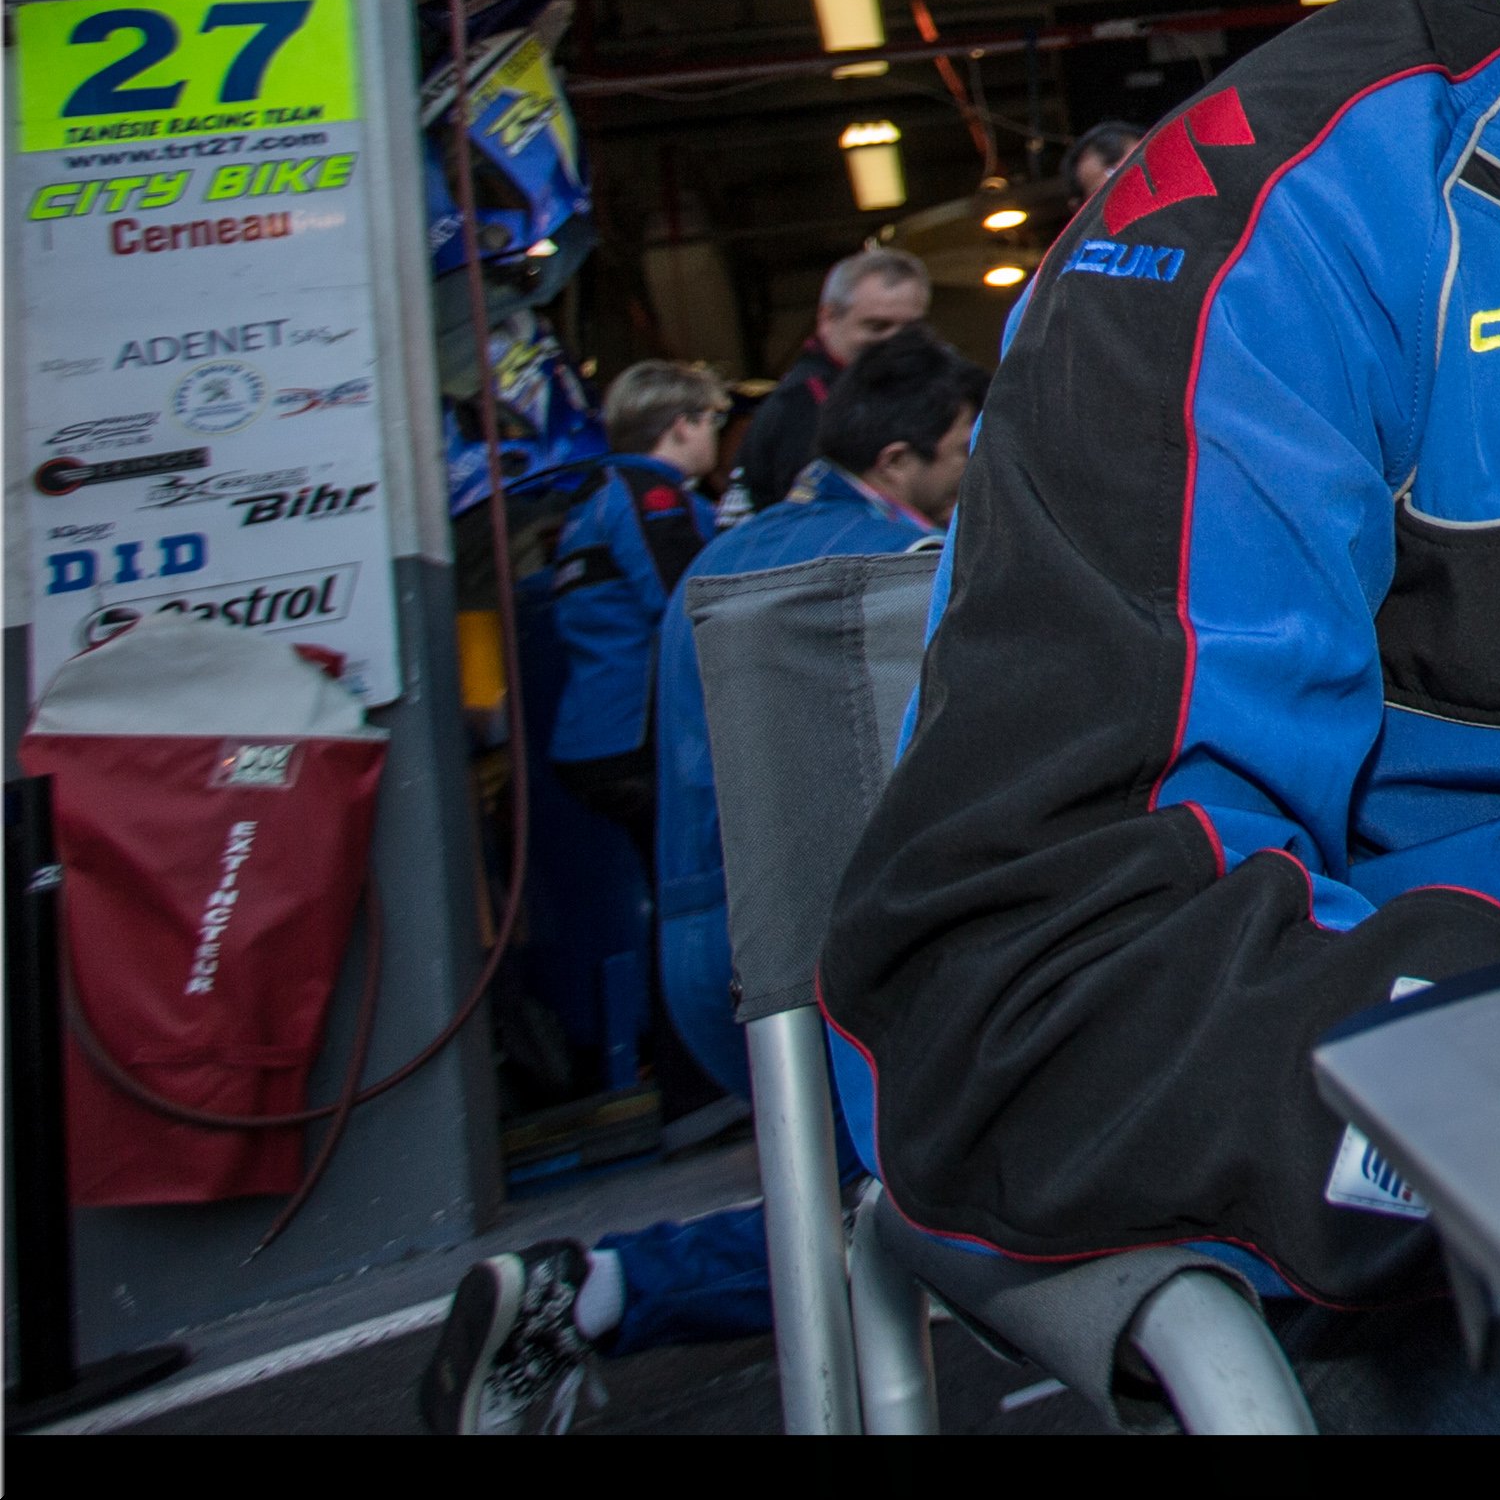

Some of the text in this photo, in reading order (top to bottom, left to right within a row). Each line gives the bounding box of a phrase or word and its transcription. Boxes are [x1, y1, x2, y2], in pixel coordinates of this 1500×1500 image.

[60, 0, 317, 119] 27
[65, 104, 327, 145] TANÉSIE RACING TEAM
[63, 131, 329, 169] www.trt27.com
[26, 151, 360, 222] CITY BIKE
[110, 210, 293, 256] Cerneau
[1057, 238, 1185, 283] ZUKI
[113, 318, 291, 370] ADENET
[229, 482, 379, 528] Bihr
[184, 820, 258, 997] EXTINCTEUR
